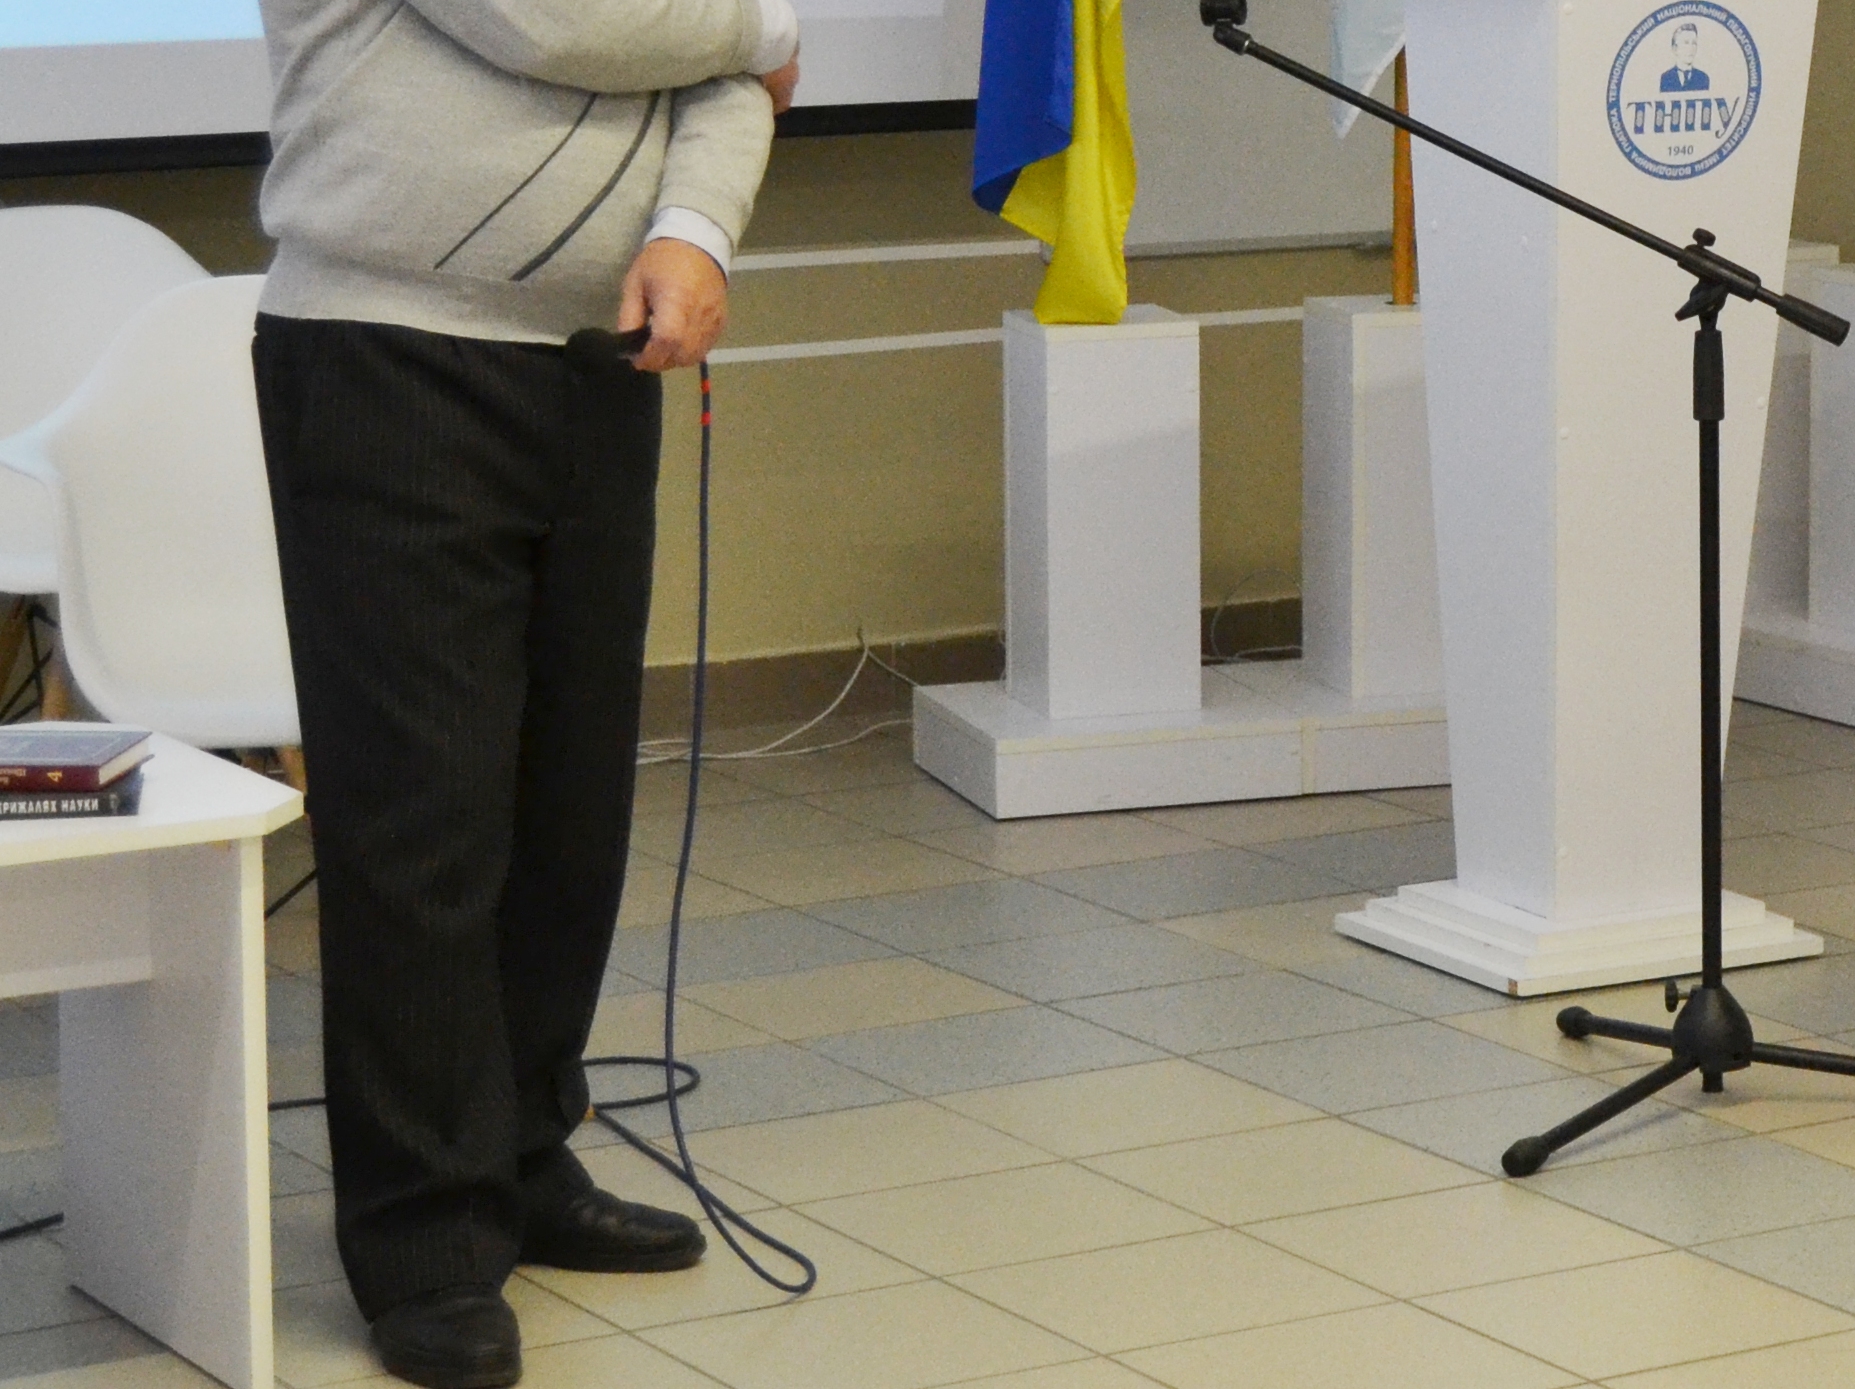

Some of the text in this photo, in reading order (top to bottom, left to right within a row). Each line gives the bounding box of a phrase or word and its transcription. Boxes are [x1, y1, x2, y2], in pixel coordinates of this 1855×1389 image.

[1656, 3, 1728, 22] НАЦІОНАЛЬНИЙ
[1608, 16, 1655, 103] ТЕРНОПІЛЬСЬКИЙ
[1726, 19, 1758, 87] ПЕДАГОГІЧНИЙ
[1626, 96, 1740, 139] ТНПУ
[1722, 91, 1757, 156] УНІВЕРСИТЕТ
[1631, 151, 1692, 177] ВОЛОДИМИРА
[1667, 145, 1694, 156] 1940
[61, 797, 99, 813] НАУКИ
